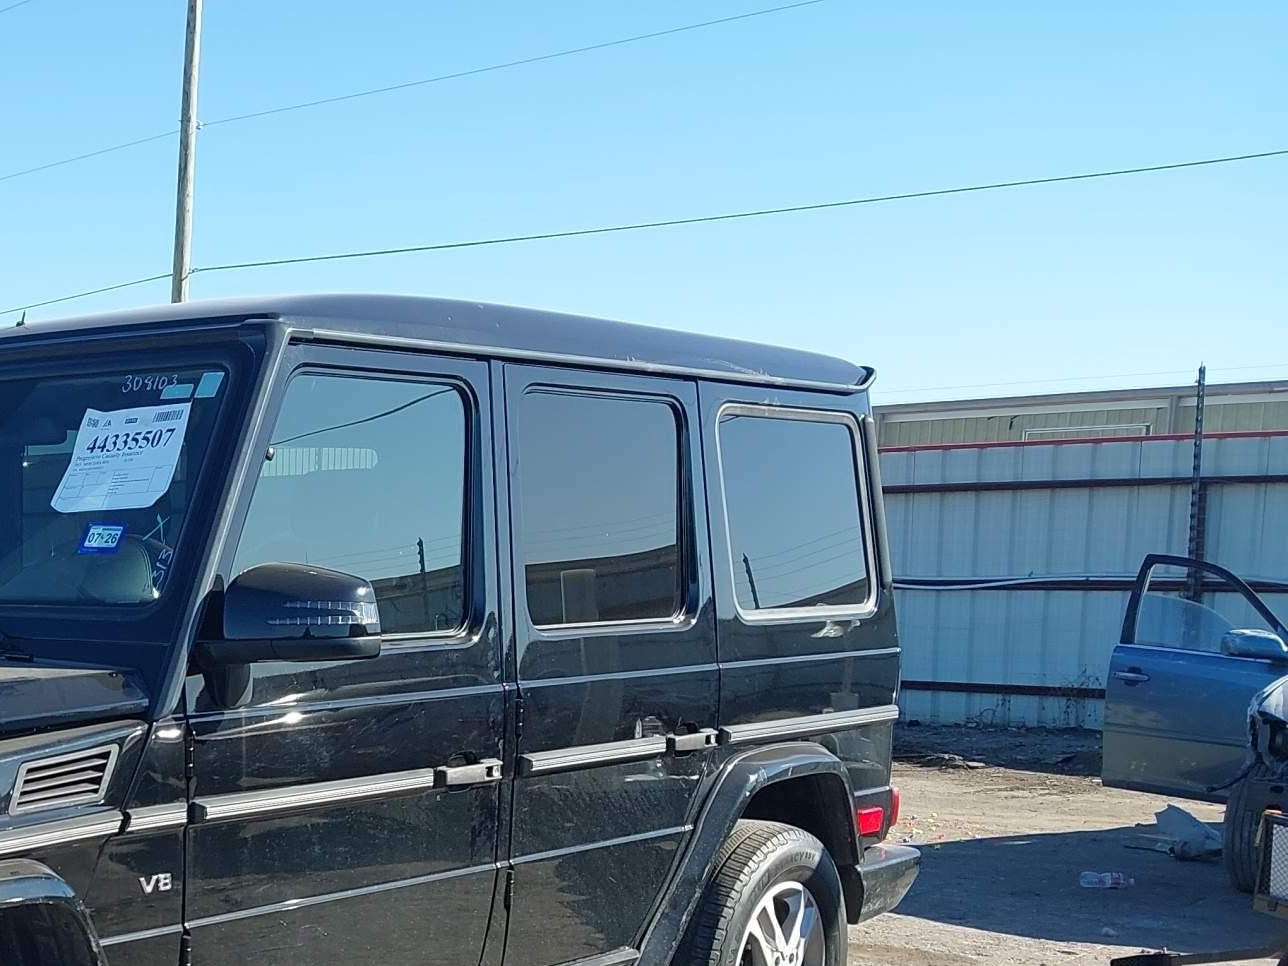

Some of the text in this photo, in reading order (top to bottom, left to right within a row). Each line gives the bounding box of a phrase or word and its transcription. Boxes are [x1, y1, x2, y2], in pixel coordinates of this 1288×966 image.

[86, 428, 177, 454] 44335507
[104, 532, 119, 544] 26
[139, 873, 172, 895] V8
